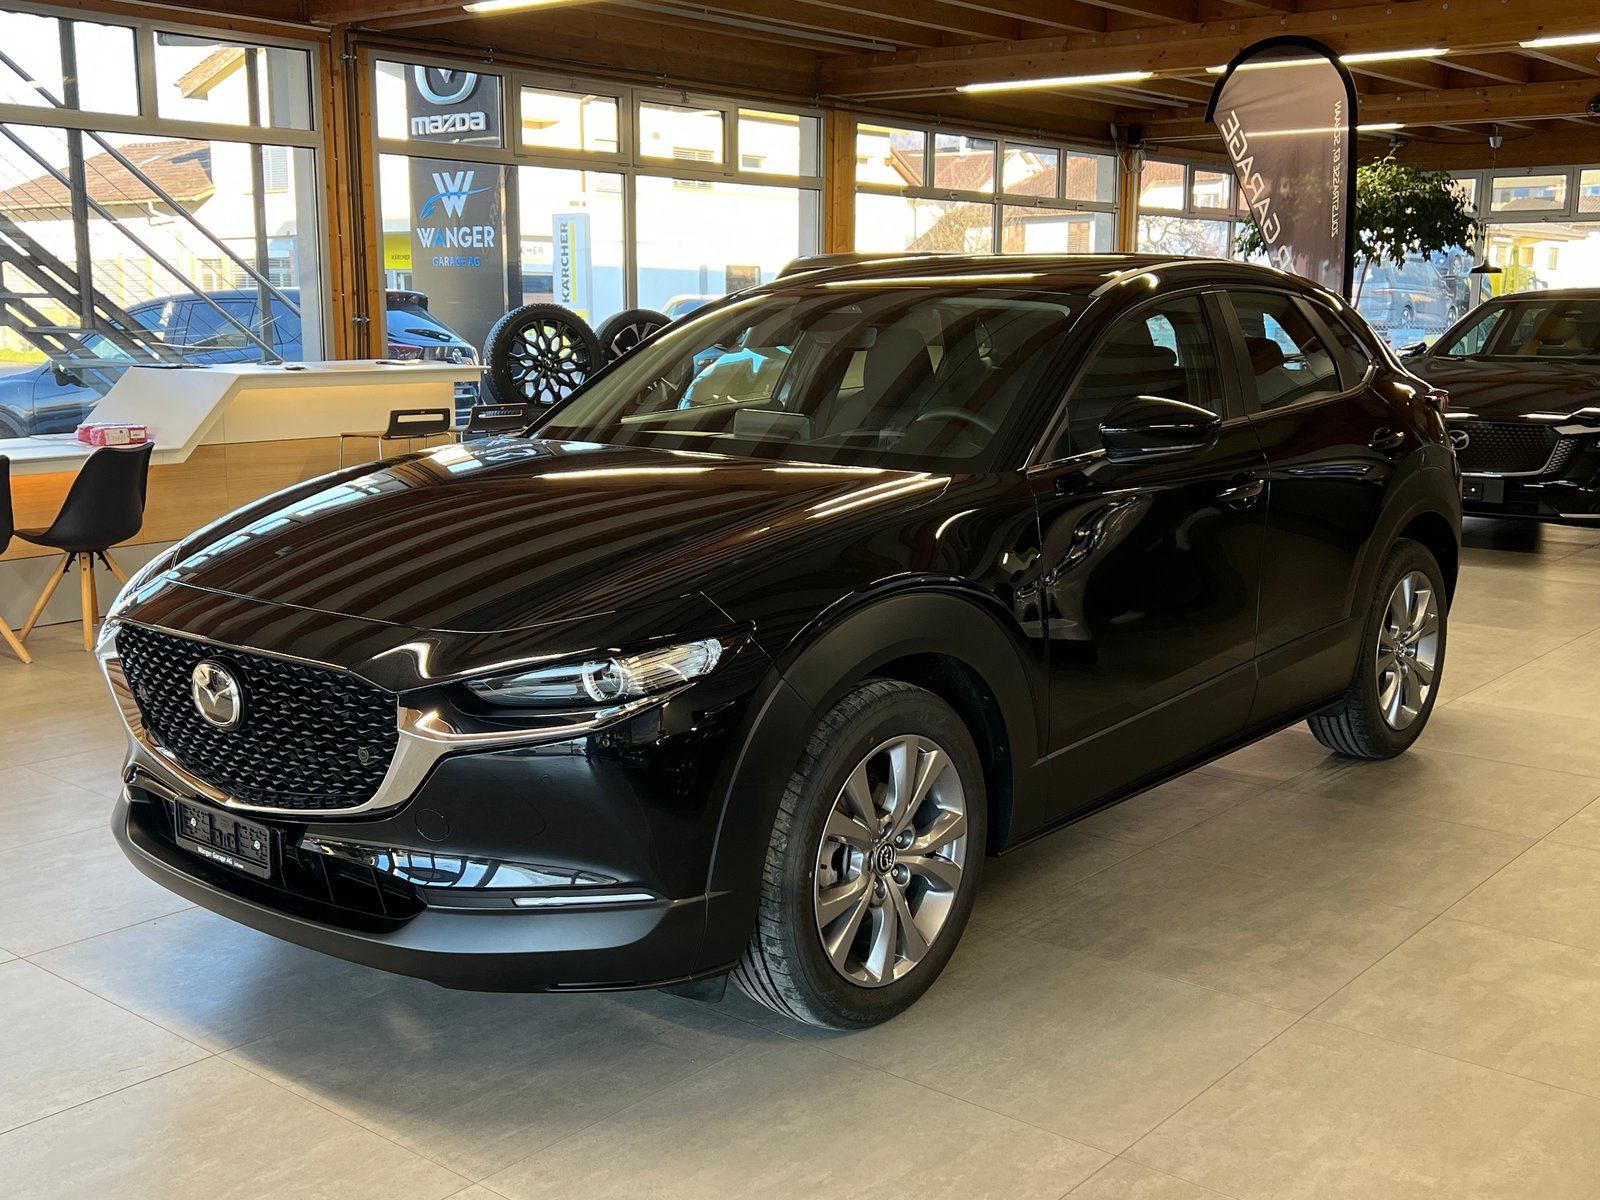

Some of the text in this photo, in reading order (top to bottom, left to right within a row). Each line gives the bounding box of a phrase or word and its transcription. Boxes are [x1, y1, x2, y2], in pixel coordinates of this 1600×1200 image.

[417, 225, 494, 249] WANGER
[432, 255, 480, 267] GARAGE AG
[561, 222, 570, 303] KÄRCHER
